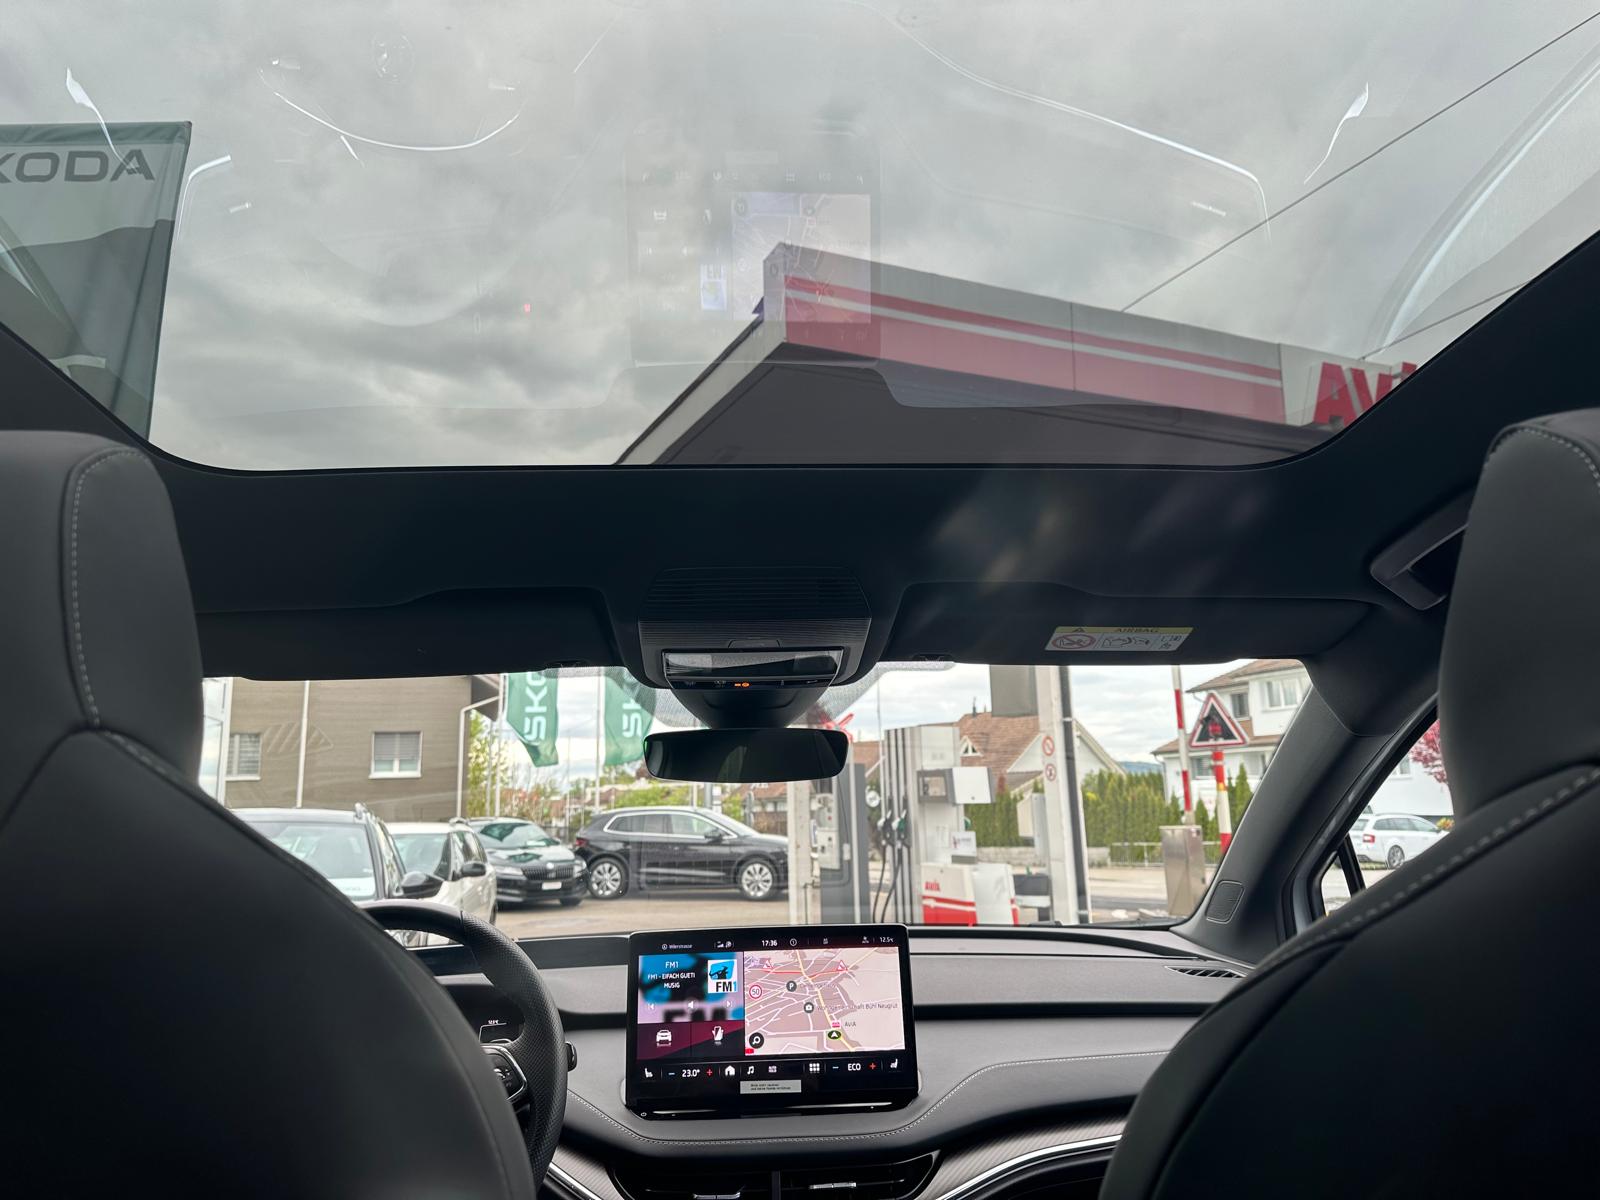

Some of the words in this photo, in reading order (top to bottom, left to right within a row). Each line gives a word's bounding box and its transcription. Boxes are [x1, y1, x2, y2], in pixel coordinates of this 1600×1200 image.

[1313, 361, 1417, 427] AV
[665, 961, 679, 969] FM1
[715, 981, 737, 993] FM1
[847, 1063, 861, 1071] ECO
